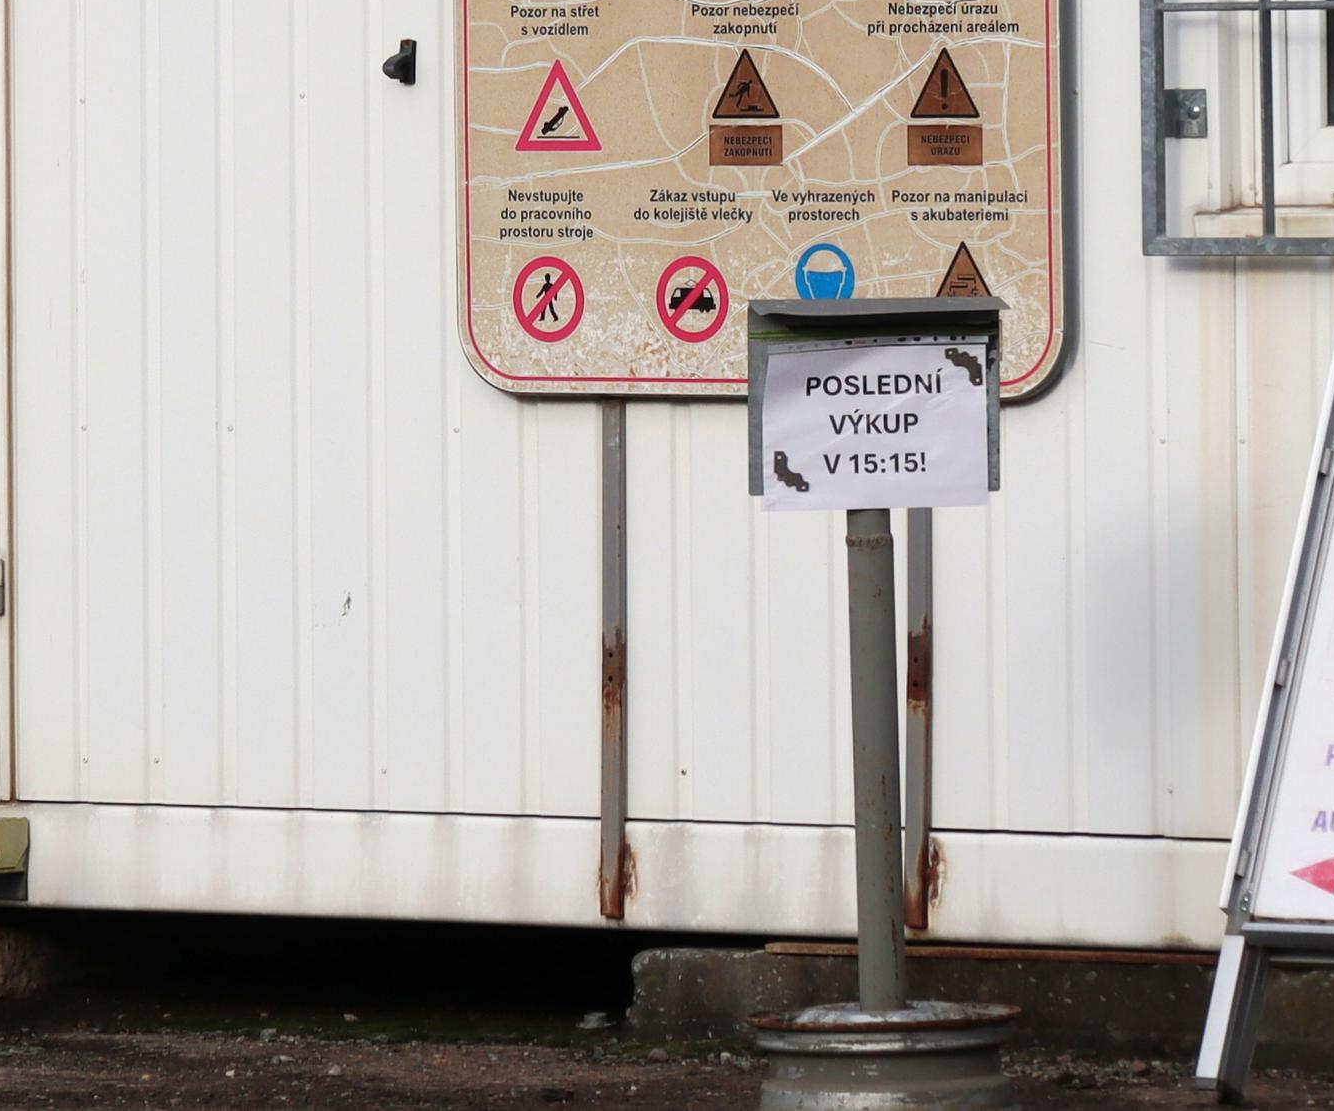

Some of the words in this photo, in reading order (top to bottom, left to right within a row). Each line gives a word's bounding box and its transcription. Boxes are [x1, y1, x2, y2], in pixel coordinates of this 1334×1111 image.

[510, 5, 548, 19] Pozor
[551, 7, 568, 18] na
[571, 4, 600, 18] střet
[691, 4, 729, 17] Pozor
[733, 2, 799, 18] nebezpečí
[888, 1, 957, 17] Nebezpečí
[961, 2, 998, 15] úrazu
[520, 24, 528, 36] s
[532, 21, 589, 36] vozidlem
[713, 21, 777, 37] zakopnutí
[867, 19, 885, 36] při
[889, 20, 963, 35] procházení
[966, 20, 1020, 33] areálem
[508, 189, 584, 206] Nevstupujte
[649, 189, 688, 203] Zákaz
[691, 190, 736, 206] vstupu
[771, 189, 788, 203] Ve
[792, 189, 875, 207] vyhrazených
[891, 189, 930, 203] Pozor
[934, 192, 951, 203] na
[954, 189, 1028, 207] manipulaci
[500, 207, 517, 220] do
[520, 207, 592, 223] pracovního
[633, 207, 650, 220] do
[654, 206, 708, 224] kolejiště
[711, 206, 753, 224] vlečky
[788, 208, 860, 224] prostorech
[910, 210, 918, 221] s
[922, 207, 1009, 222] akubateriemi
[499, 226, 554, 240] prostoru
[557, 225, 594, 241] stroje
[805, 368, 943, 397] POSLEDNÍ
[829, 409, 920, 436] VÝKUP
[823, 453, 842, 475] V
[849, 451, 927, 474] 15:15!
